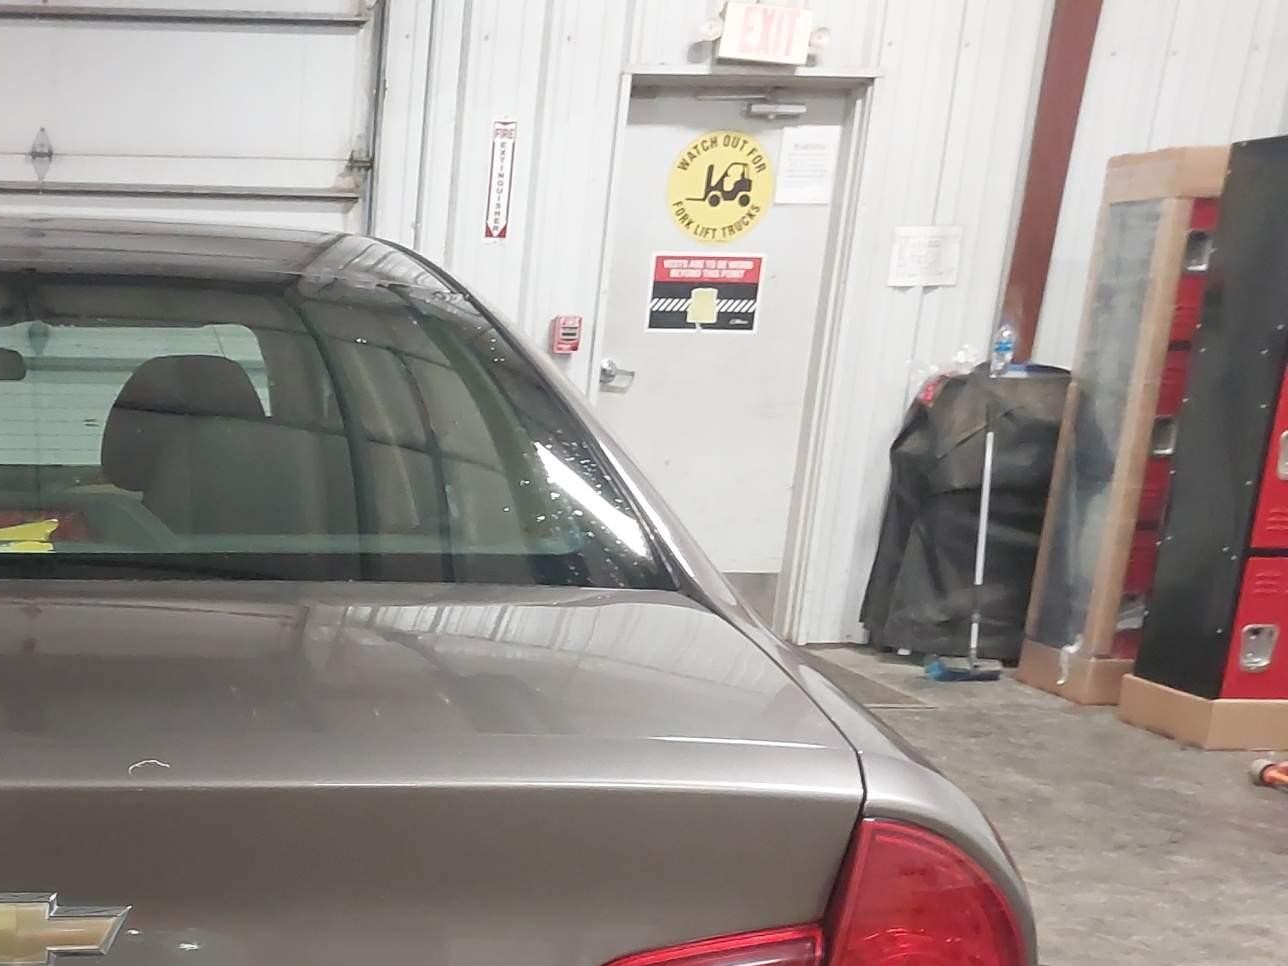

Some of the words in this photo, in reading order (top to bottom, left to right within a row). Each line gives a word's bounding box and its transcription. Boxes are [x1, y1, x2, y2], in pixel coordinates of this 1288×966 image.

[738, 6, 802, 57] EXIT
[495, 128, 515, 139] FIRE
[677, 136, 719, 171] WATCH
[722, 134, 748, 151] OUT
[746, 147, 767, 173] FOR
[492, 141, 507, 232] EXTINGUISHER
[672, 201, 695, 230] FORK
[693, 223, 717, 240] LIFT
[720, 204, 761, 239] TRUCKS
